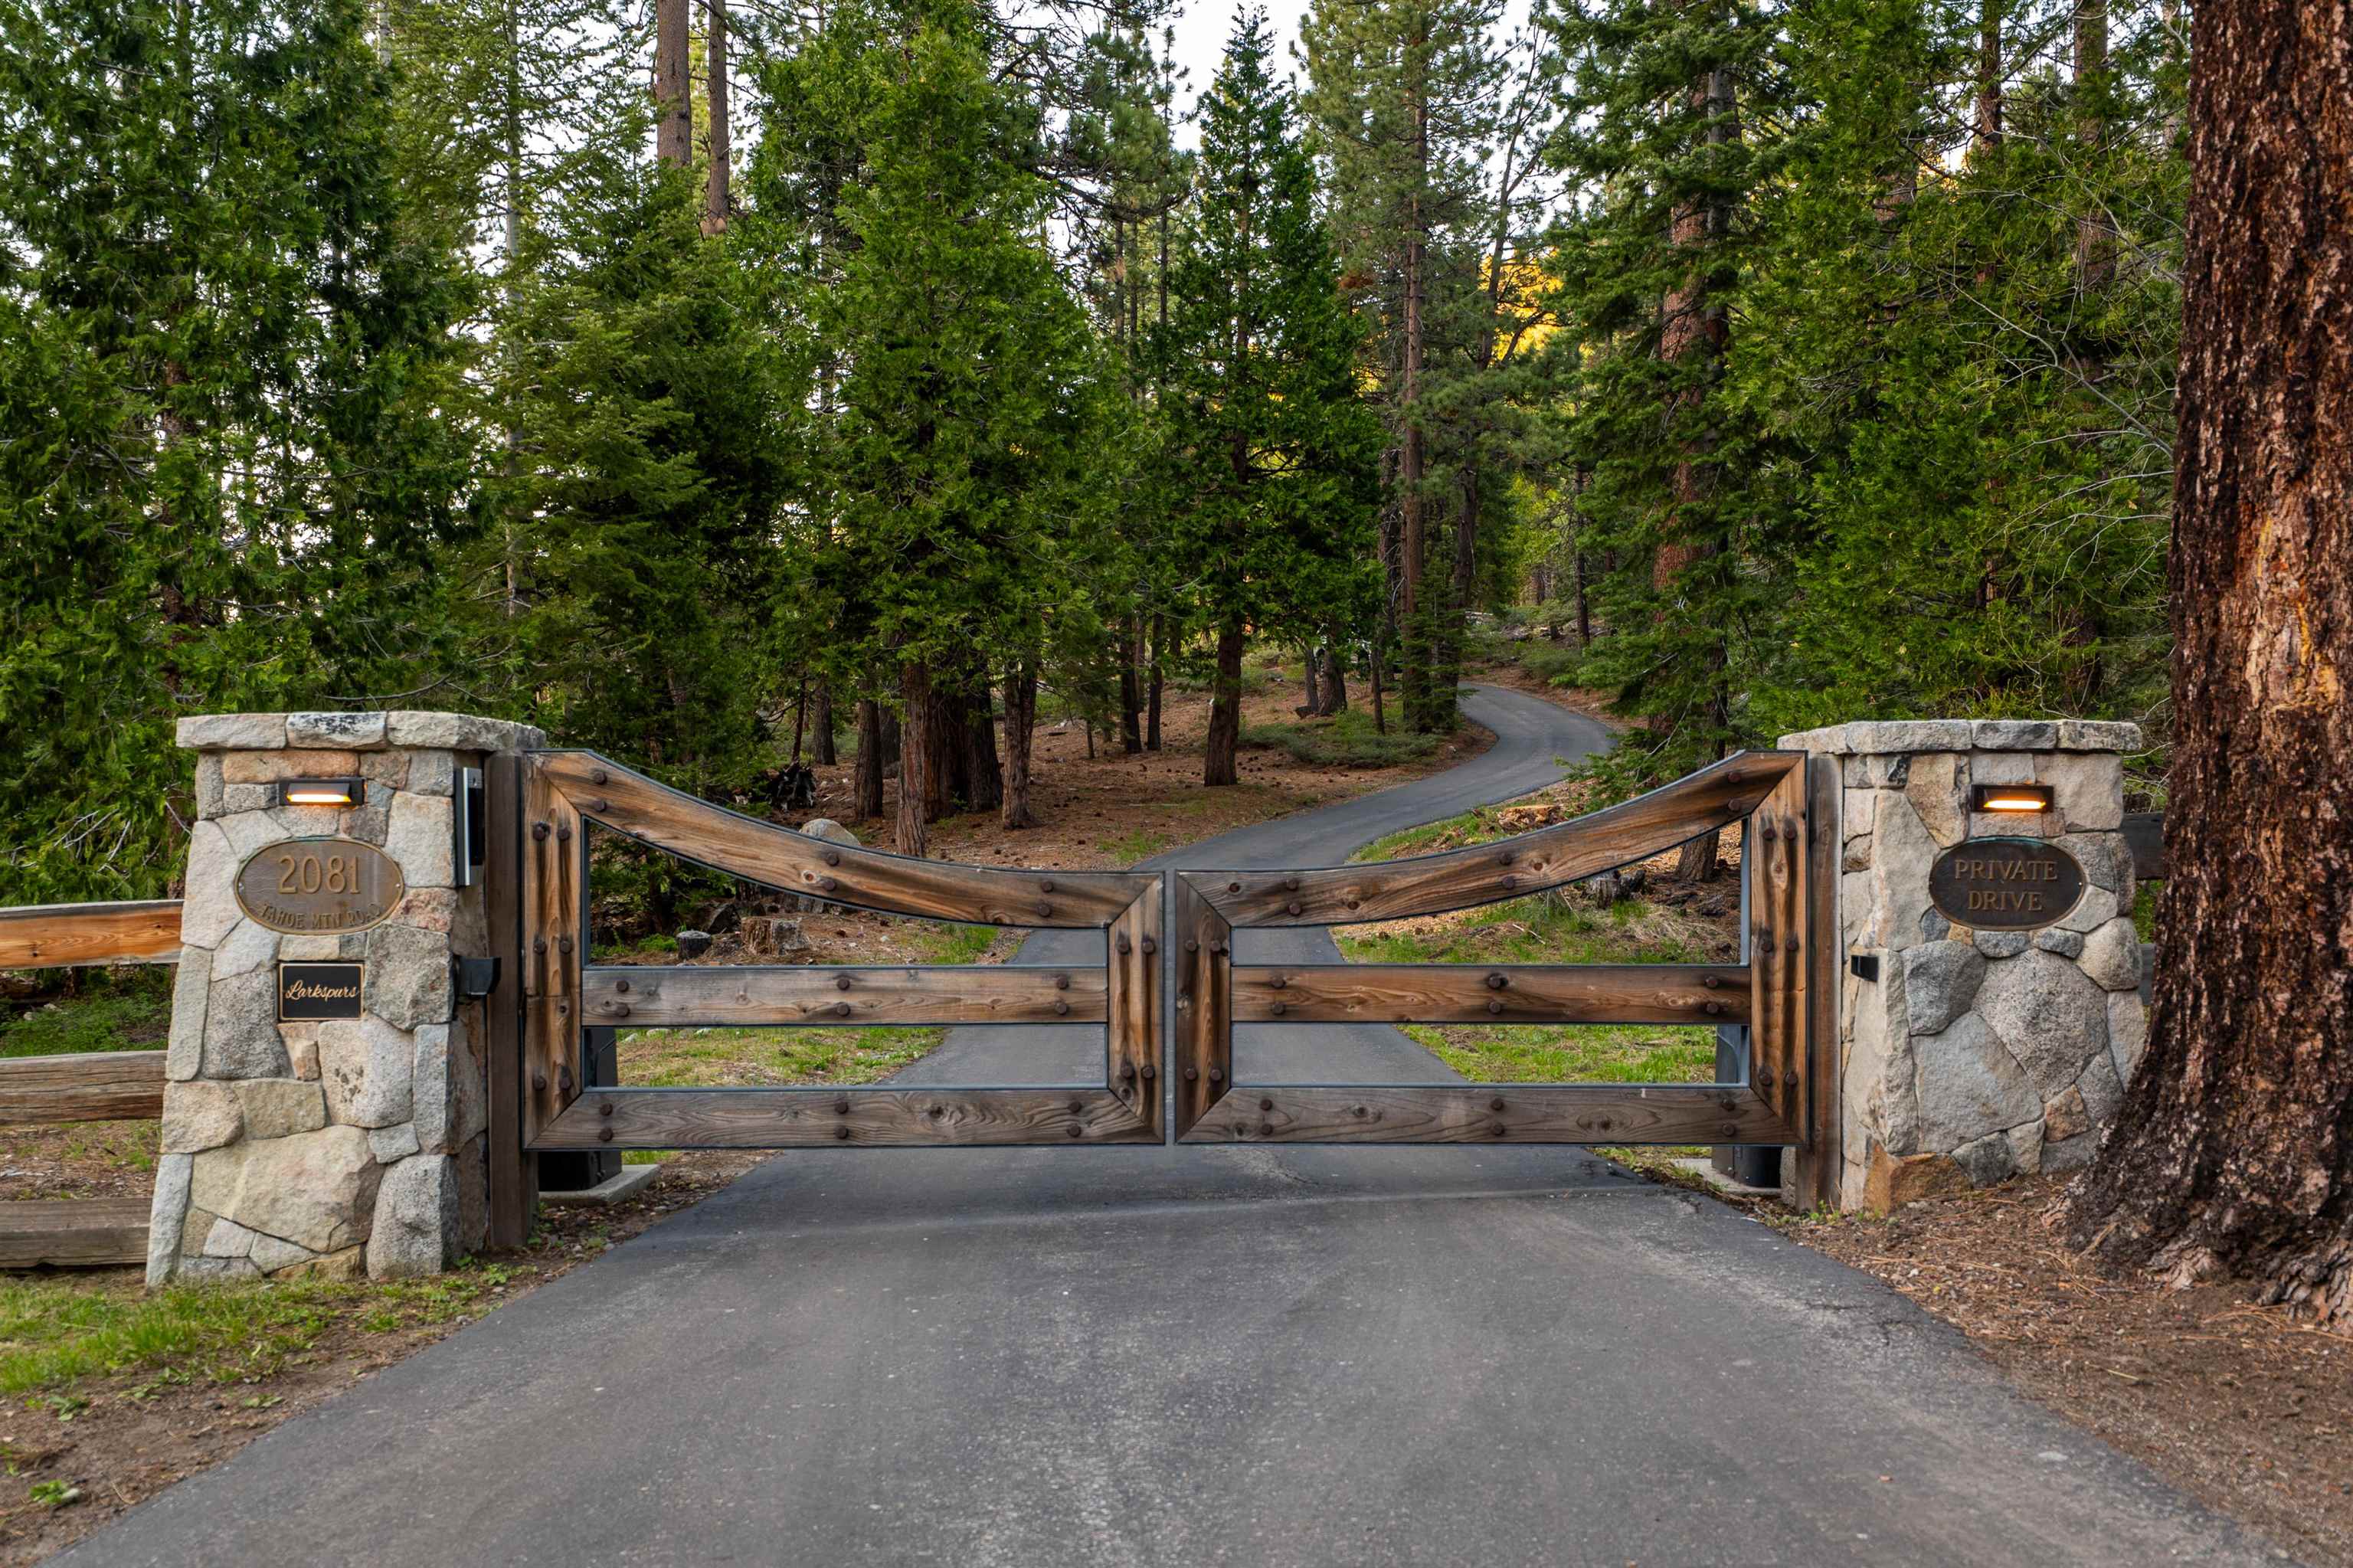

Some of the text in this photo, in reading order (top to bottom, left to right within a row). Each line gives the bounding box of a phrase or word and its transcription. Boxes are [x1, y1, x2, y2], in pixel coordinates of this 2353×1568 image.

[277, 854, 361, 895] 2081
[1954, 859, 2058, 881] PRIVATE
[1967, 890, 2044, 912] DRIVE
[260, 903, 306, 929] TAHOE
[311, 912, 343, 930] MTN
[284, 979, 360, 1003] Larkspurs
